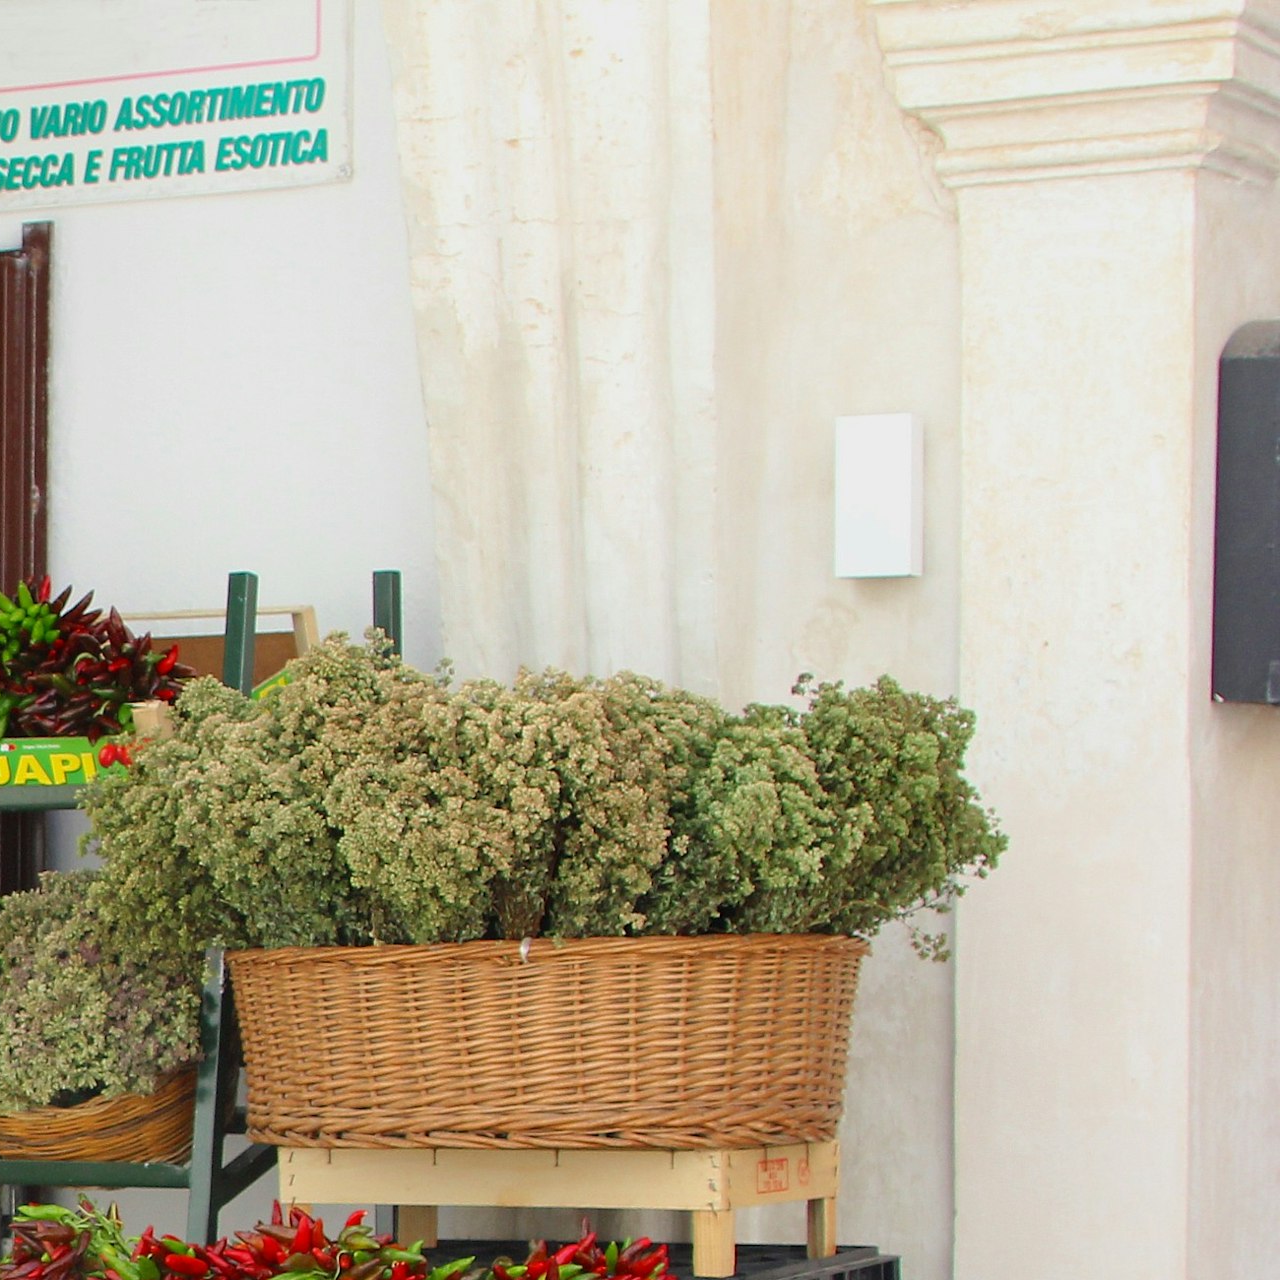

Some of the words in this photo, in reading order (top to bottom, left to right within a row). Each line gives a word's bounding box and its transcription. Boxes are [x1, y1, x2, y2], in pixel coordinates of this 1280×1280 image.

[30, 99, 108, 140] VARIO
[114, 77, 326, 132] ASSORTIMENTO
[83, 149, 103, 184] E
[109, 140, 207, 181] FRUTTA
[215, 128, 328, 172] ESOTICA
